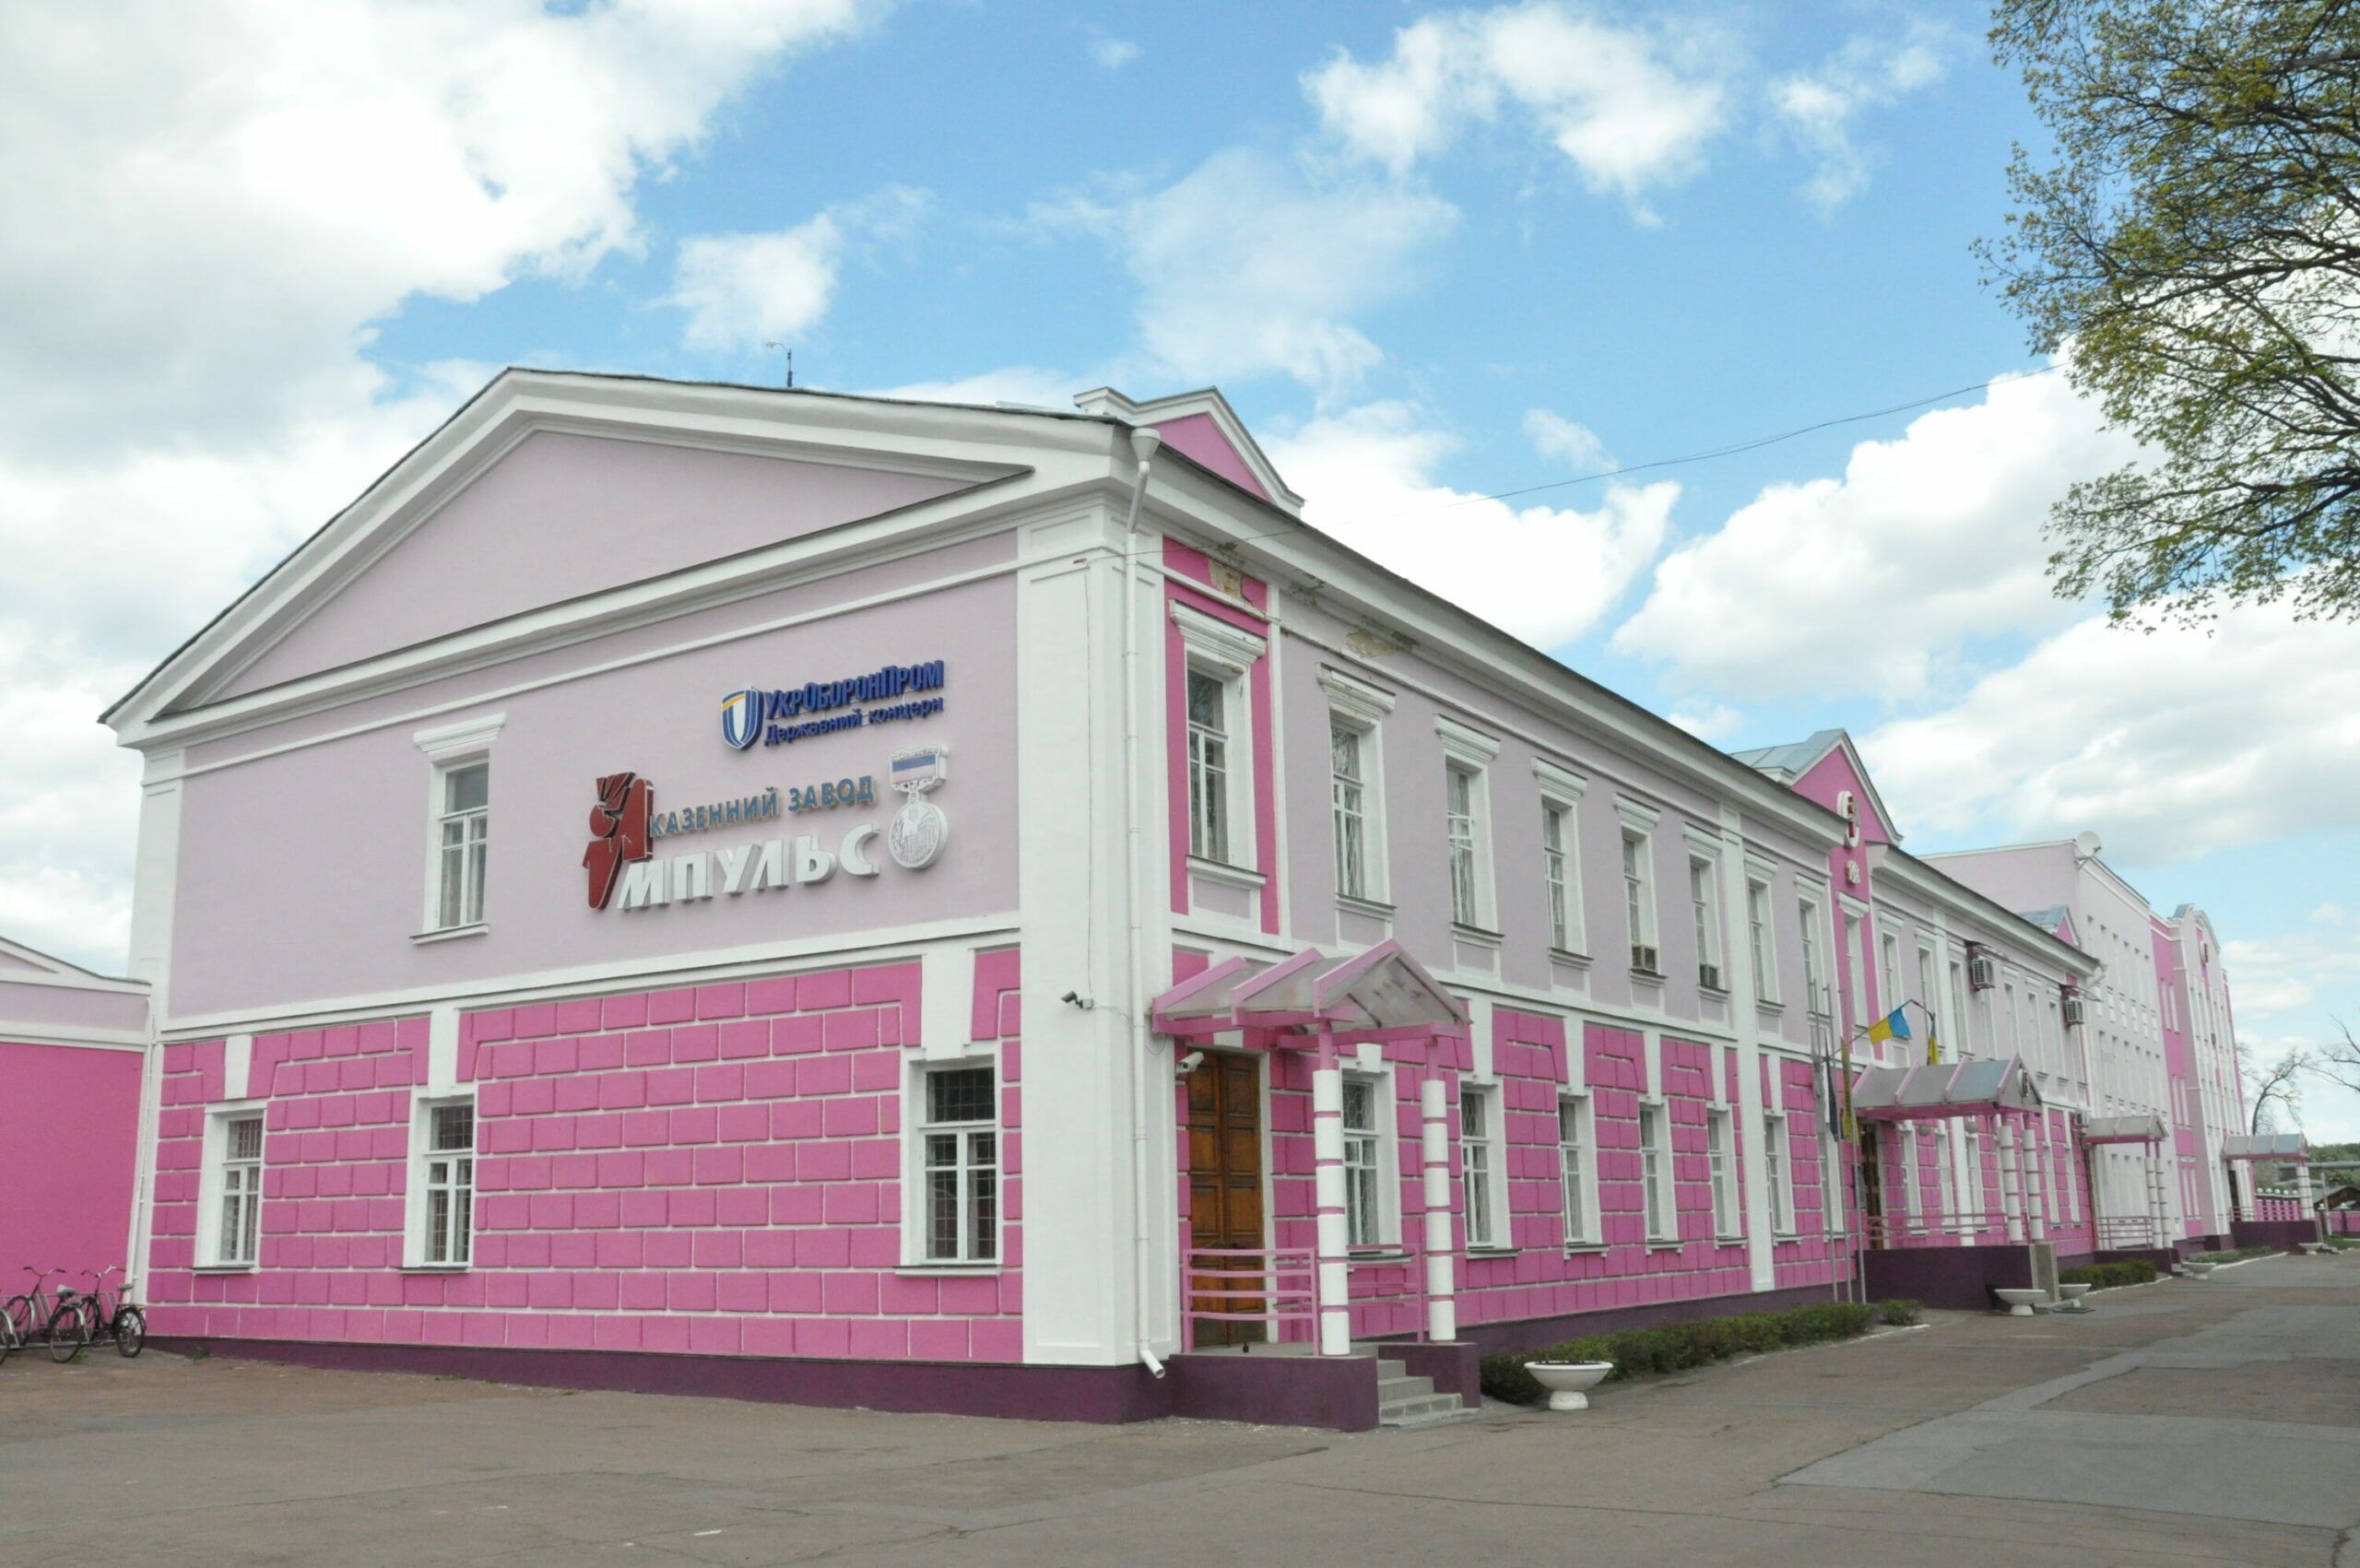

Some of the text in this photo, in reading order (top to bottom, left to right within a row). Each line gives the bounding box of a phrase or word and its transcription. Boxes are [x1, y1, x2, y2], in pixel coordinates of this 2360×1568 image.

[764, 697, 944, 747] Державний концерн
[650, 775, 876, 838] КАЗЕННИЙ ЗАВОД
